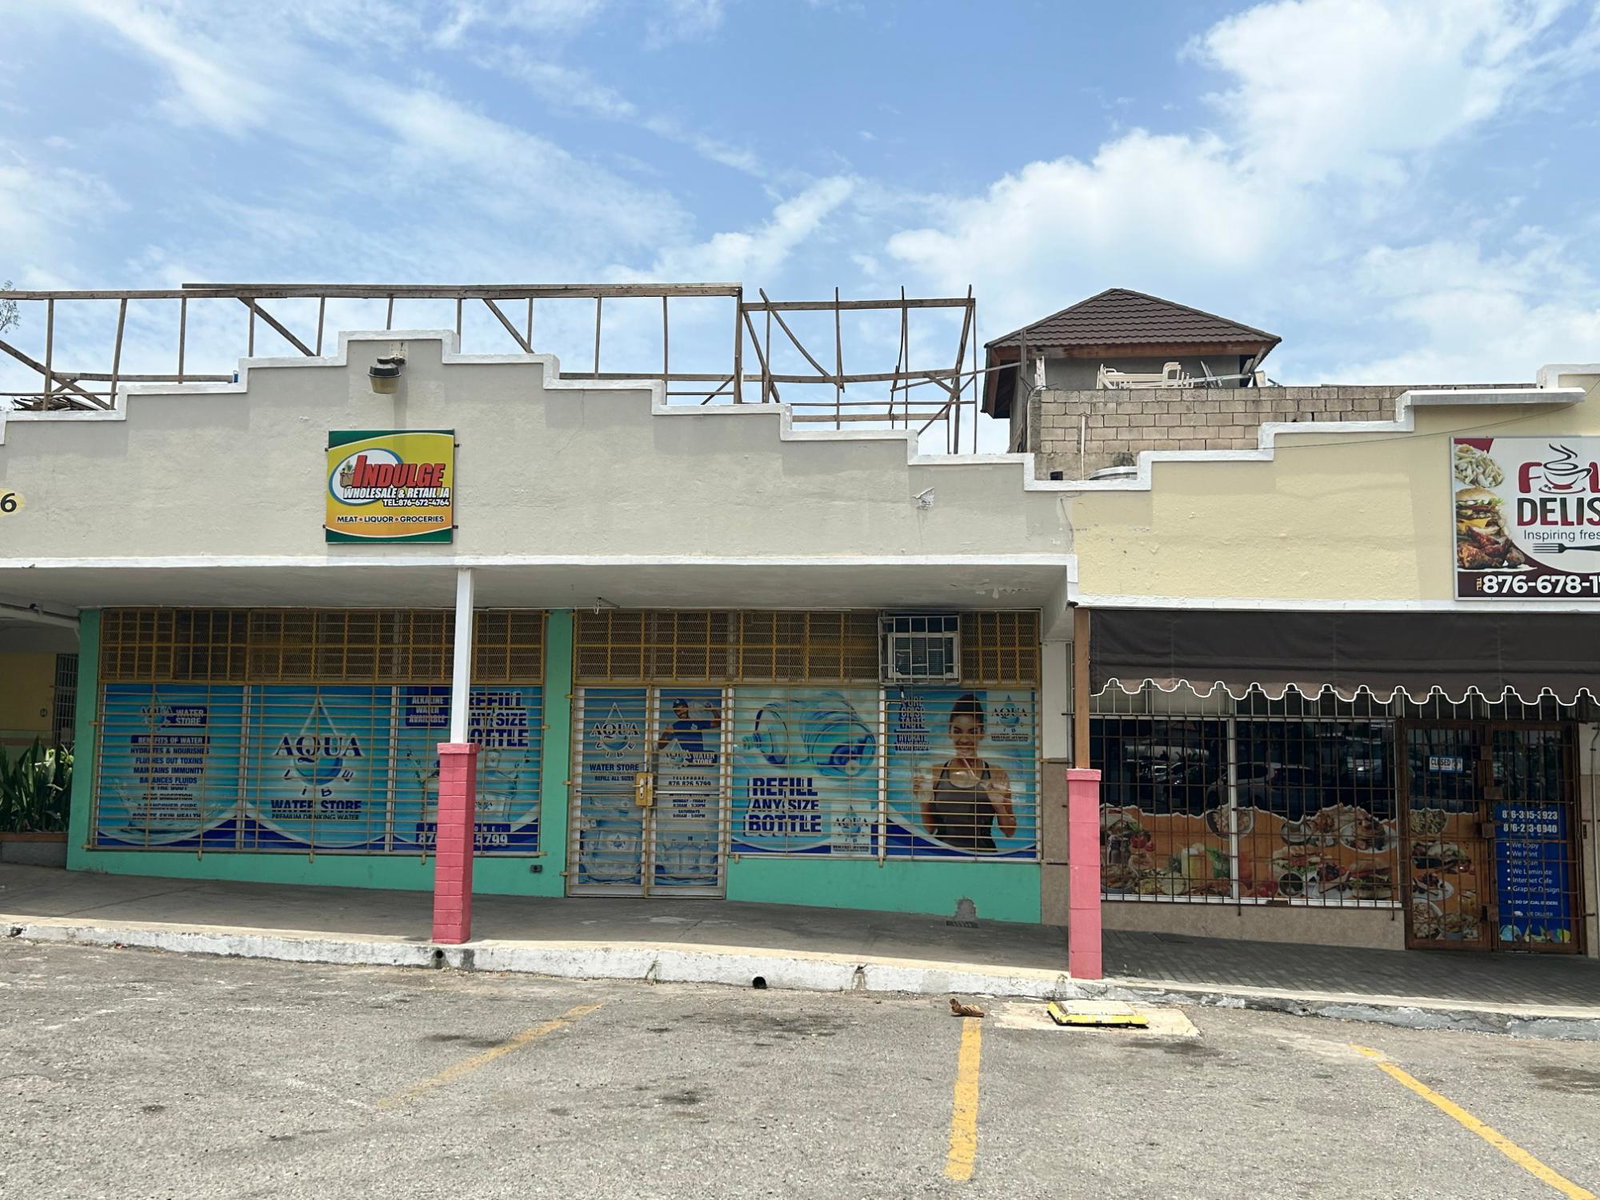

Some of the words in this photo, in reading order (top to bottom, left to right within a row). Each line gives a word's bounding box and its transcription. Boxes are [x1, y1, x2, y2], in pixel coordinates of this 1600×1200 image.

[351, 454, 446, 488] INDULGE
[343, 487, 397, 499] WHOLESALE
[405, 487, 437, 499] RETAIL
[437, 487, 450, 499] JA
[0, 492, 18, 513] 6
[1523, 529, 1576, 543] Inspiring
[1482, 575, 1600, 594] 876-678-1
[469, 691, 526, 710] EFILL
[176, 717, 202, 726] STORE
[468, 712, 492, 726] NY
[496, 712, 528, 726] SIZE
[469, 728, 529, 747] OTTLE
[590, 722, 640, 739] AQUA
[138, 736, 169, 744] BENFITS
[170, 736, 179, 744] OF
[180, 736, 203, 744] WATER
[272, 734, 365, 764] AQUA
[180, 757, 204, 765] TOXINS
[589, 763, 615, 772] WATER
[617, 763, 640, 772] STORE
[1430, 758, 1451, 767] CLSED
[752, 777, 819, 797] REFILL
[271, 800, 315, 814] WATER
[321, 800, 362, 814] STORE
[752, 799, 782, 812] ANY
[788, 799, 820, 812] SIZE
[302, 813, 336, 821] DRNKING
[748, 814, 822, 833] BOTTLE
[1538, 886, 1560, 894] Dsign
